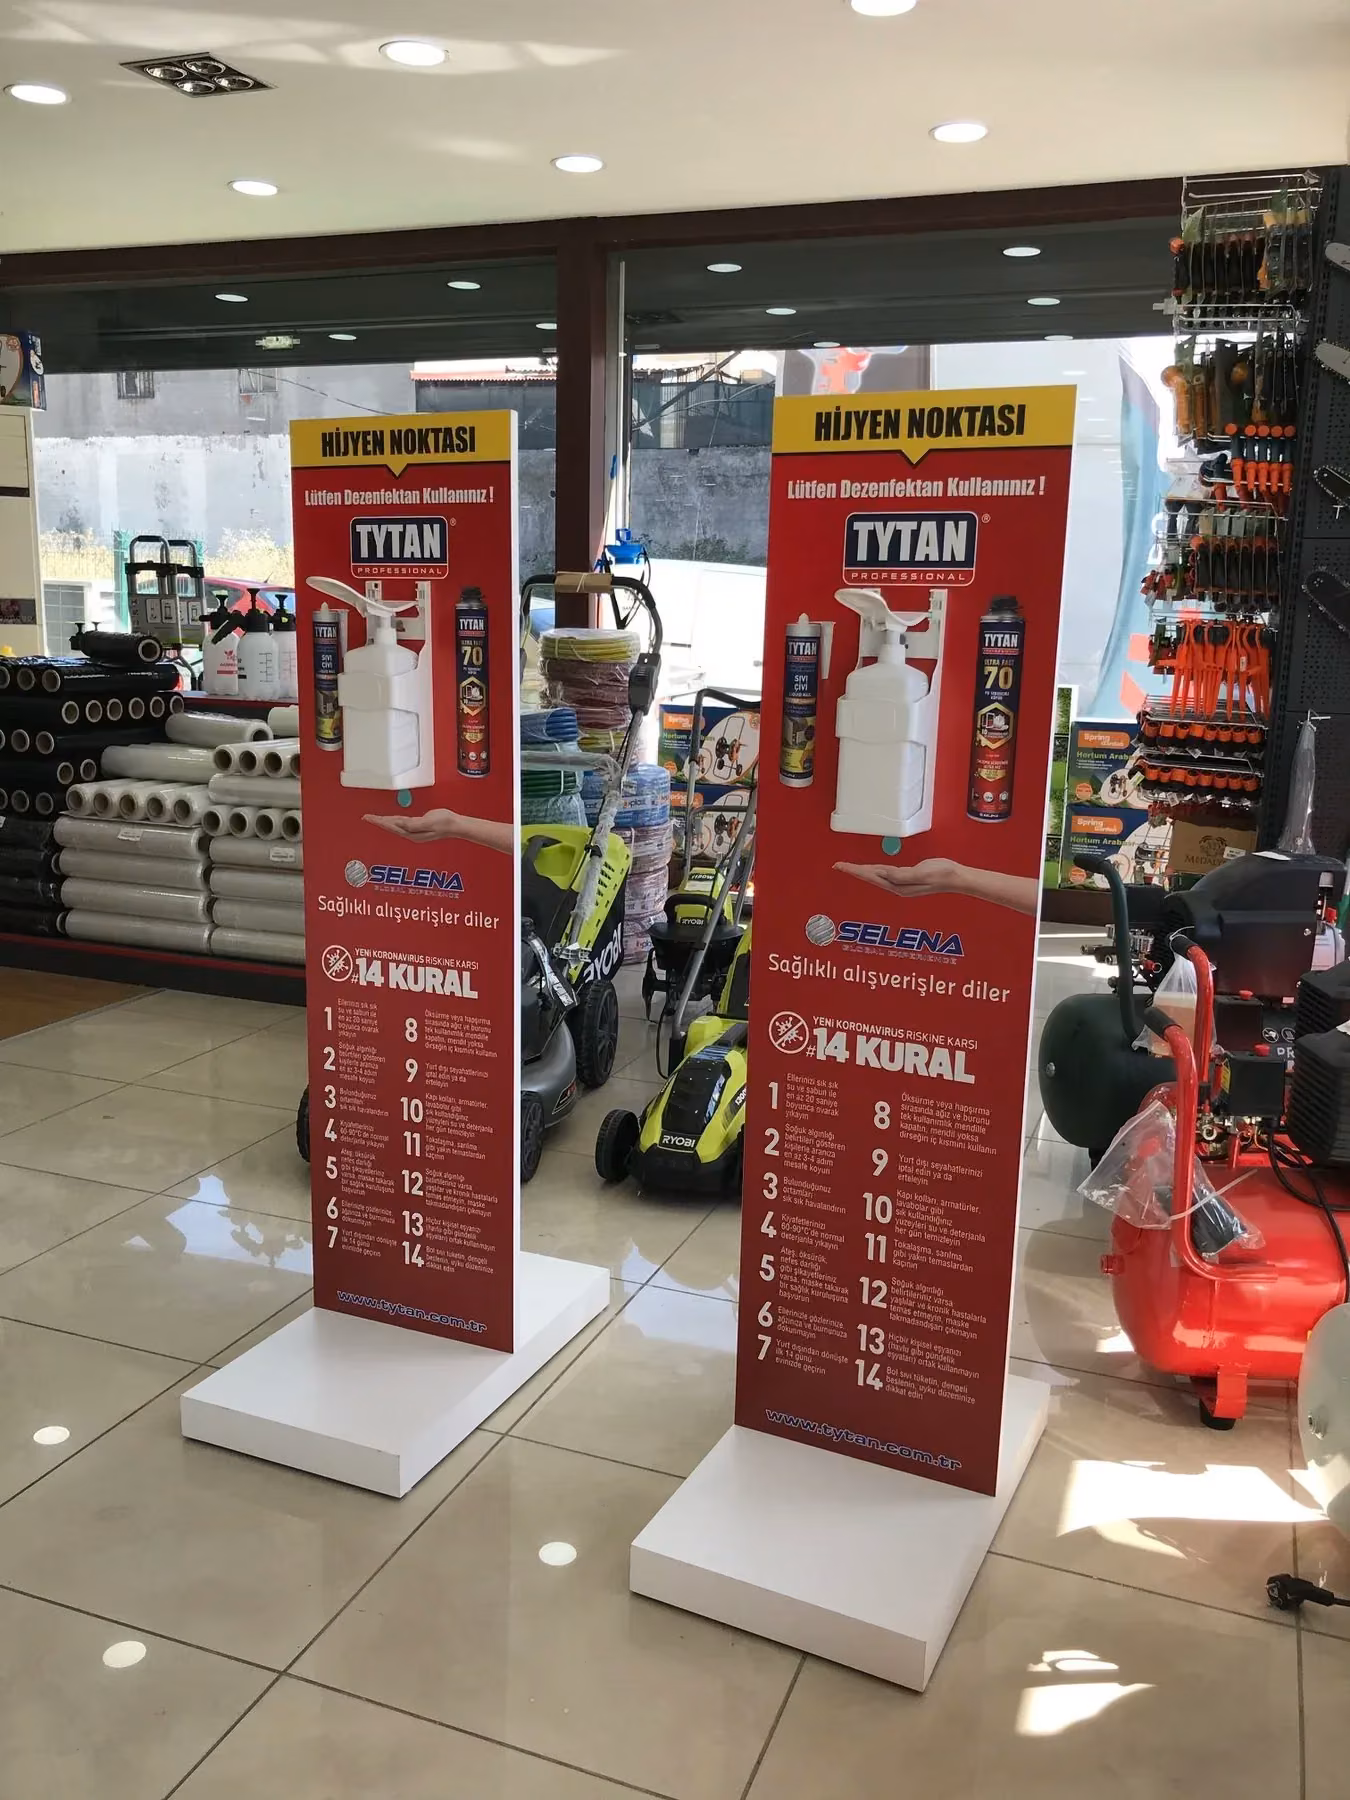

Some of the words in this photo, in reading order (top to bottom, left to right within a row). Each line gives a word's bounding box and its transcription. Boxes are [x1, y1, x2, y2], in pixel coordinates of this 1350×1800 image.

[814, 406, 901, 441] HİJYEN
[907, 404, 1026, 439] NOKTASI
[321, 427, 385, 457] HİJYEN
[389, 426, 476, 455] NOKTASI
[305, 490, 342, 506] Lütfen
[344, 488, 420, 505] Dezenfektan
[787, 480, 837, 499] Lütfen
[840, 478, 943, 498] Dezenfektan
[947, 477, 1036, 497] Kullanınız
[355, 523, 440, 558] TYTAN
[853, 520, 968, 562] TYTAN
[357, 566, 442, 574] PROFESSIONAL
[851, 572, 966, 581] PROFESSIONAL
[315, 626, 337, 638] TYTAN
[460, 619, 484, 630] TYTAN
[788, 642, 817, 656] TYTAN
[984, 633, 1018, 648] TYTAN
[461, 646, 483, 666] 70
[984, 666, 1013, 689] 70
[367, 864, 464, 892] SELENA
[318, 895, 371, 917] Sağlıklı
[375, 902, 460, 927] alışverişler
[464, 911, 499, 929] diler
[834, 921, 964, 956] SELENA
[389, 962, 478, 999] KURAL
[768, 953, 837, 980] Sağlıklı
[843, 965, 956, 997] alışverişler
[962, 979, 1010, 1002] diler
[324, 1006, 332, 1030] 1
[405, 1016, 417, 1043] 8
[323, 1045, 335, 1070] 2
[405, 1057, 418, 1083] 9
[855, 1034, 975, 1085] KURAL
[324, 1084, 336, 1109] 3
[768, 1081, 778, 1109] 1
[400, 1096, 423, 1123] 10
[873, 1099, 891, 1130] 8
[324, 1117, 337, 1142] 4
[403, 1130, 420, 1156] 11
[662, 1135, 696, 1148] RYOBI
[764, 1126, 780, 1156] 2
[325, 1155, 337, 1180] 5
[870, 1147, 888, 1178] 9
[401, 1168, 423, 1195] 12
[762, 1170, 778, 1200] 3
[326, 1195, 338, 1220] 6
[861, 1191, 893, 1225] 10
[327, 1225, 338, 1249] 7
[401, 1209, 423, 1237] 13
[760, 1209, 777, 1239] 4
[401, 1240, 424, 1268] 14
[863, 1231, 886, 1263] 11
[759, 1252, 775, 1282] 5
[858, 1275, 888, 1308] 12
[337, 1290, 487, 1333] www.tytan.com.tr
[757, 1299, 773, 1328] 6
[756, 1333, 771, 1362] 7
[856, 1322, 885, 1355] 13
[853, 1357, 884, 1391] 14
[765, 1409, 962, 1470] www.tytan.com.tr
